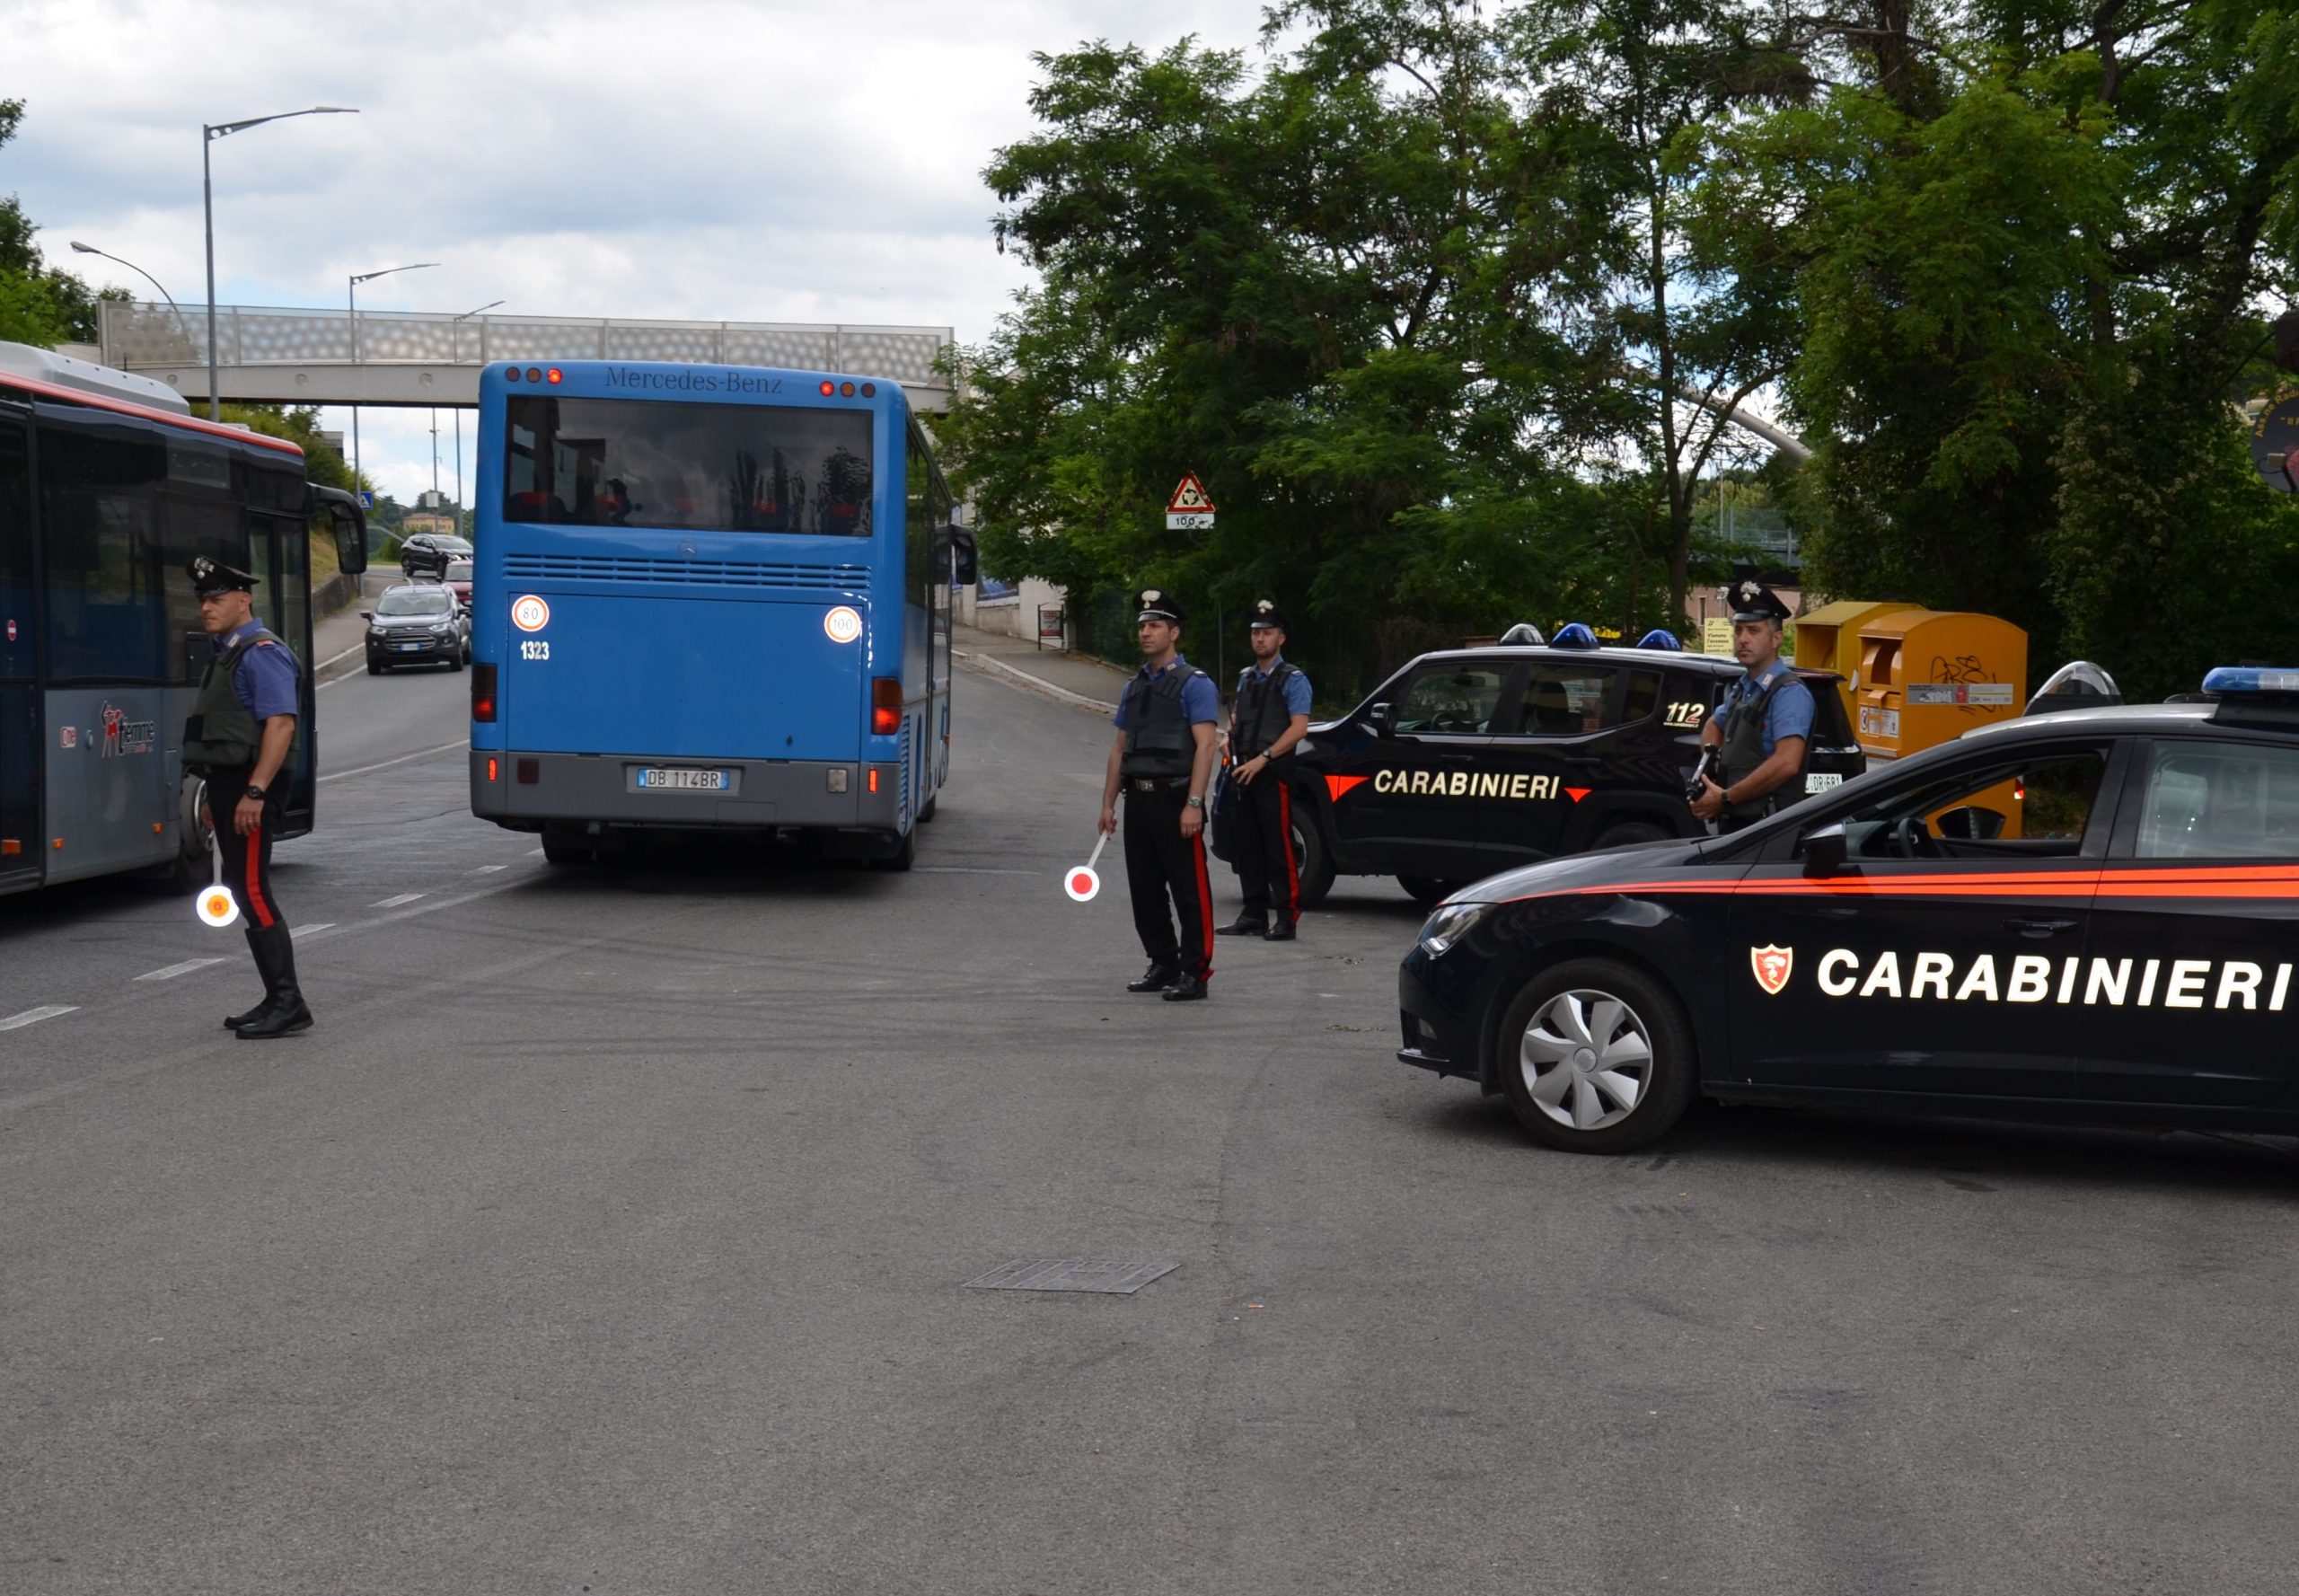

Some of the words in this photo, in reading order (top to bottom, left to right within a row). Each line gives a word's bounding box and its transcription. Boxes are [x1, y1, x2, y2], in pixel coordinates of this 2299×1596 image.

[605, 366, 782, 394] Mercedes-Benz
[1176, 516, 1195, 525] 100
[523, 607, 539, 619] 80
[520, 640, 550, 660] 1323
[1666, 701, 1705, 724] 112
[648, 771, 666, 786] DB
[674, 772, 720, 788] 114BR
[1374, 769, 1561, 799] CARABINIERI
[1817, 948, 2294, 1011] CARABINIERI
